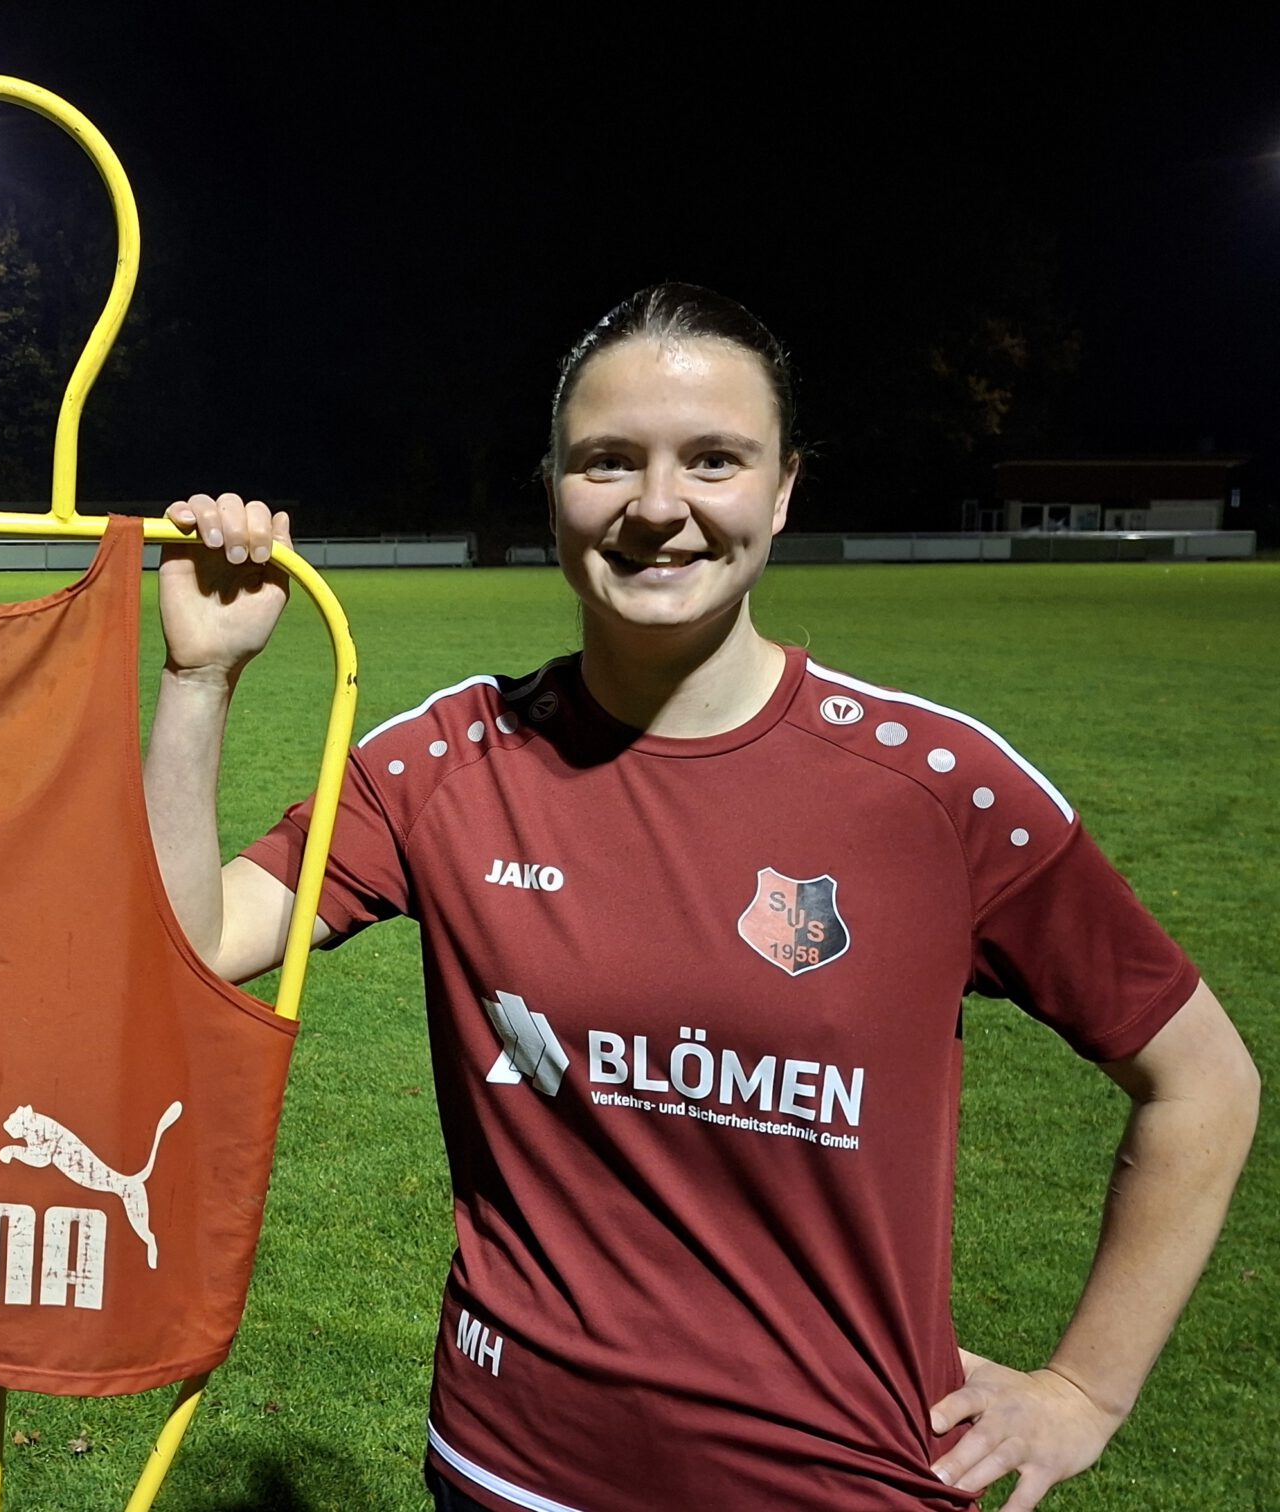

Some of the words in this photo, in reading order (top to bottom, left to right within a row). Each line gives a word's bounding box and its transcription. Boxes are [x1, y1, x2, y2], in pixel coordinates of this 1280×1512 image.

[484, 859, 564, 892] JAKO
[769, 942, 820, 965] 1958
[588, 1026, 865, 1127] BLÖMEN
[591, 1090, 656, 1111] Verkehrs-
[658, 1101, 686, 1116] und
[688, 1104, 818, 1143] Sicherheitstechnik
[819, 1131, 859, 1150] GmbH
[456, 1308, 504, 1378] MH
